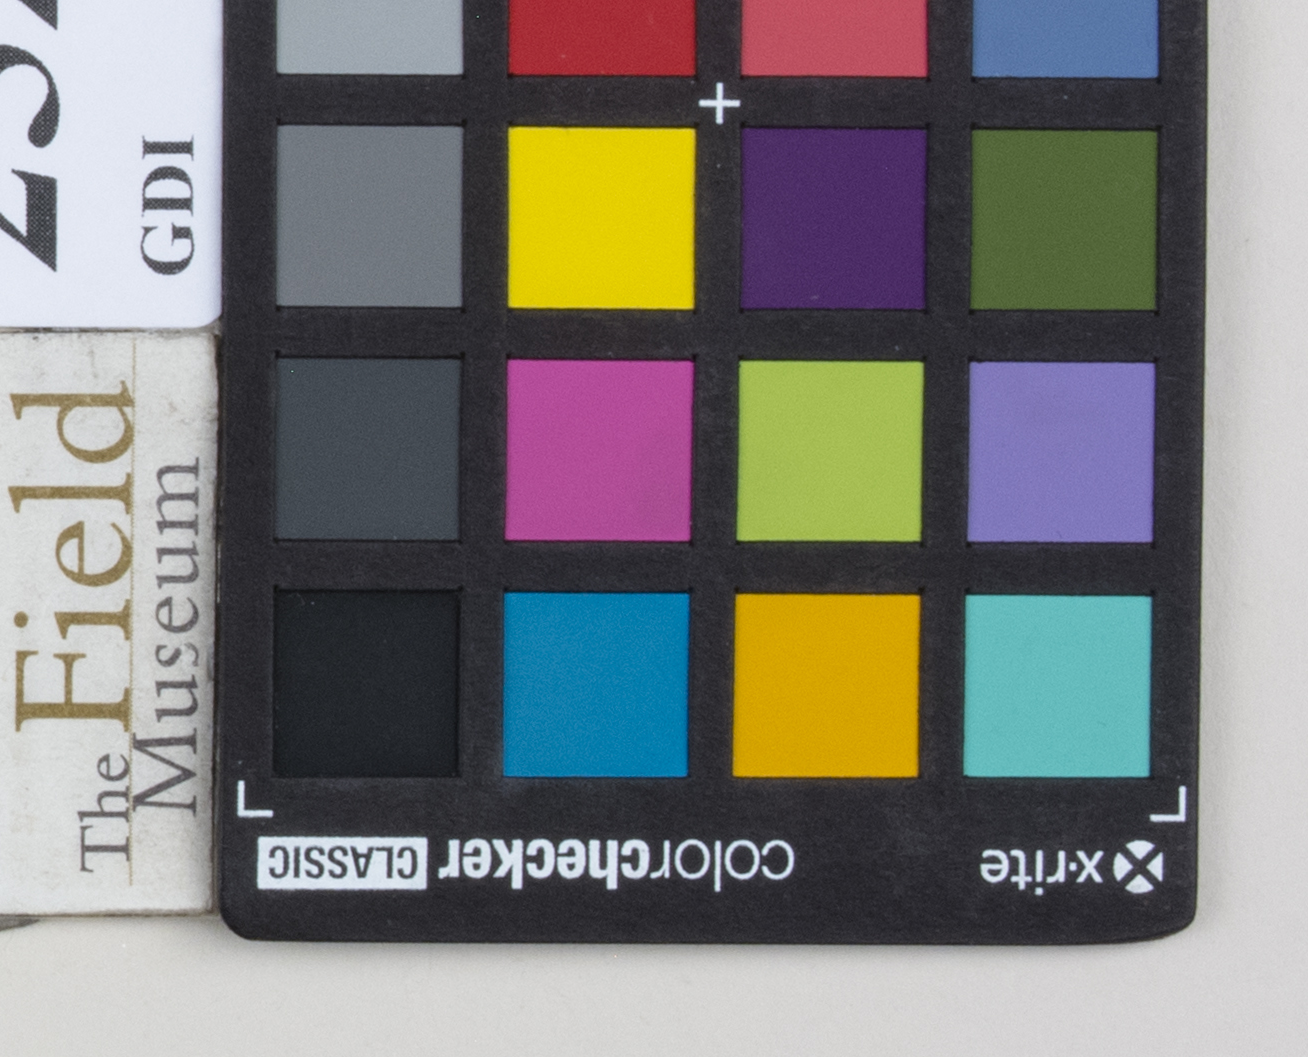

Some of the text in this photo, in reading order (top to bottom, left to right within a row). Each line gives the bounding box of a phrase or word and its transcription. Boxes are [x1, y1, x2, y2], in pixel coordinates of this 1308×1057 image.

[140, 134, 197, 275] GDI
[7, 379, 134, 874] The Field
[131, 455, 200, 819] Museum
[268, 837, 795, 893] colorchecker CLASSIC
